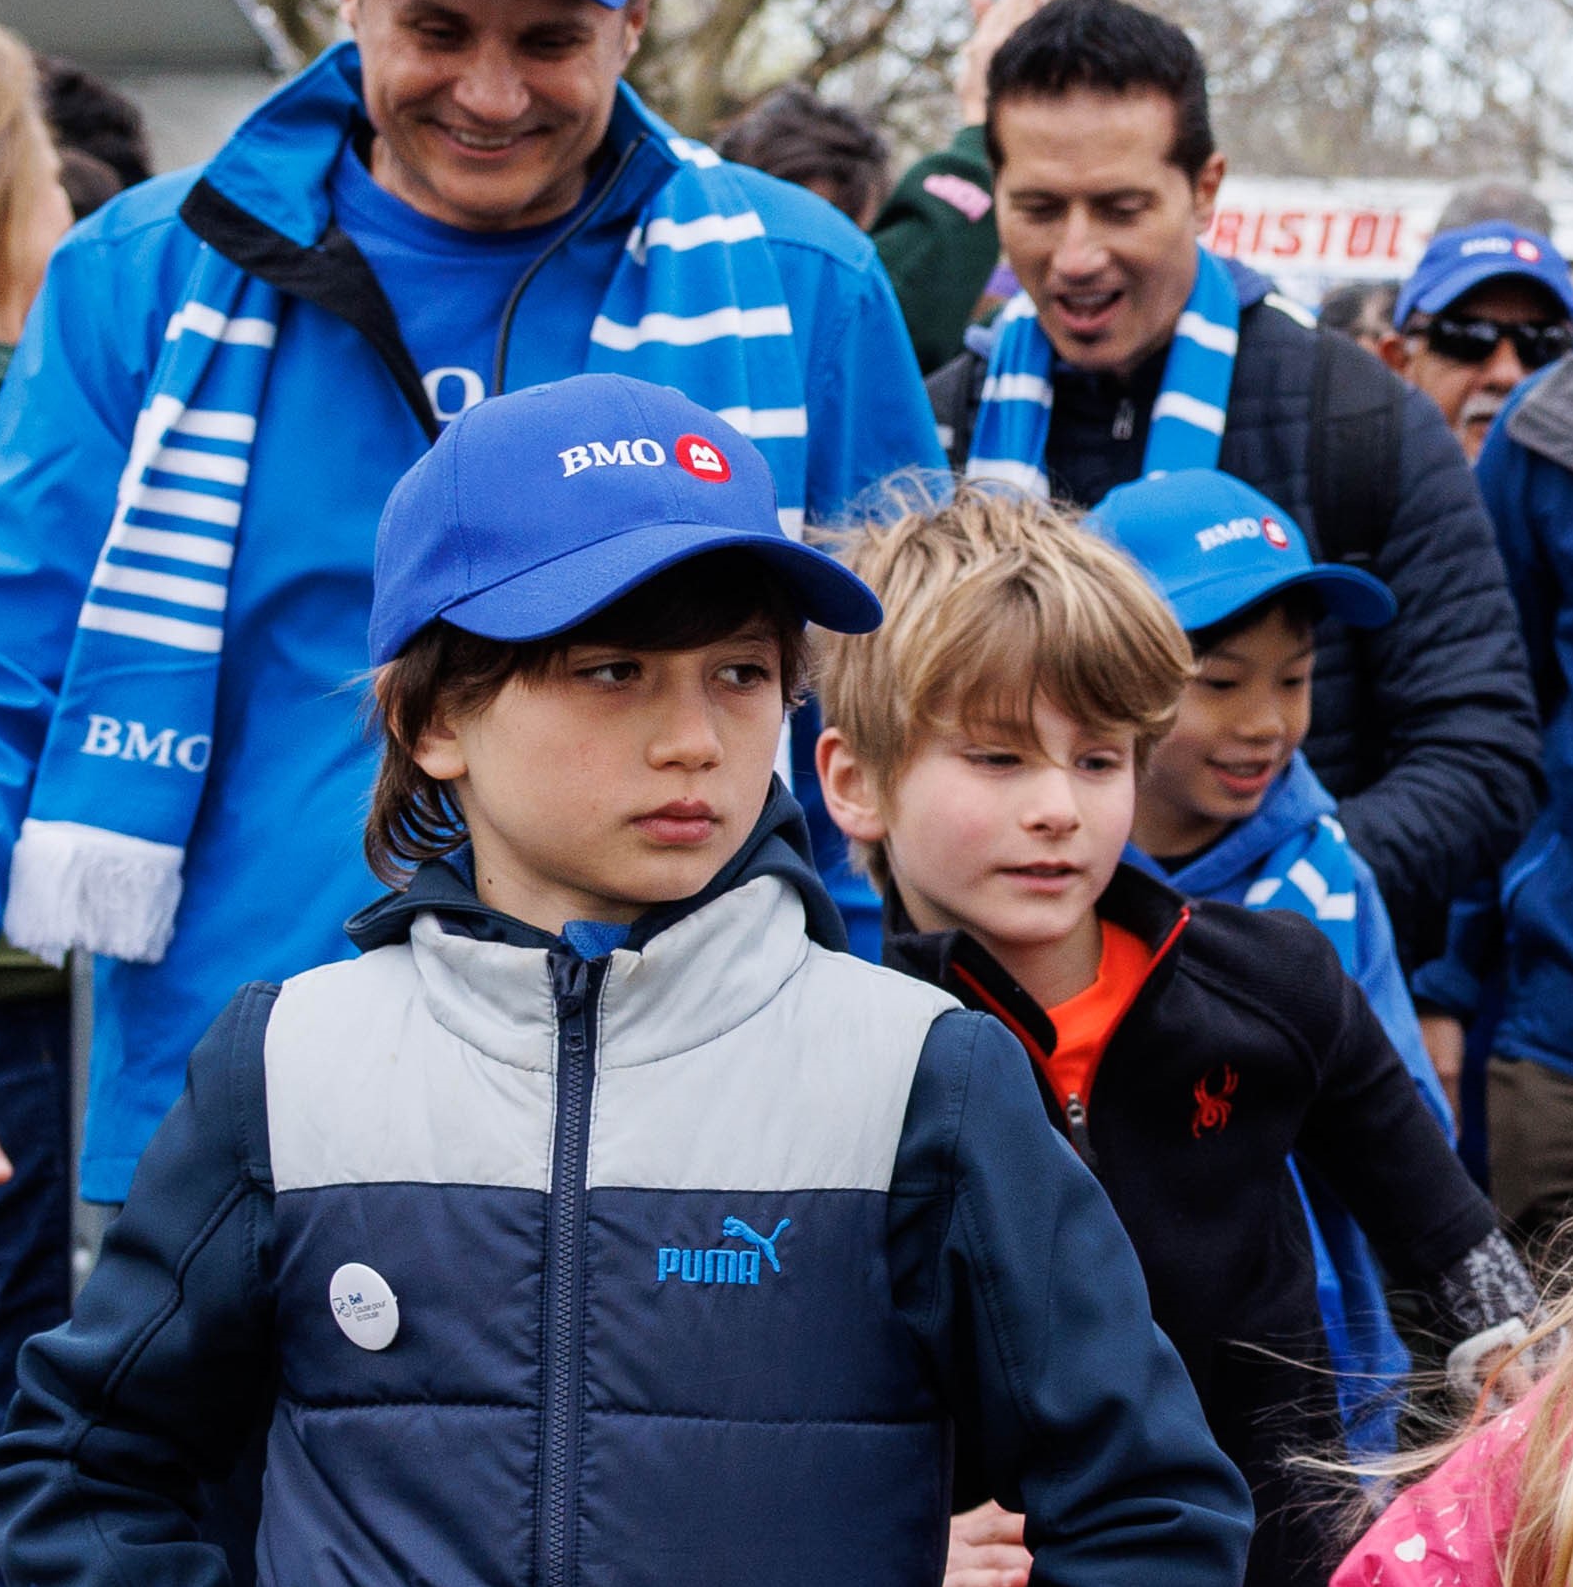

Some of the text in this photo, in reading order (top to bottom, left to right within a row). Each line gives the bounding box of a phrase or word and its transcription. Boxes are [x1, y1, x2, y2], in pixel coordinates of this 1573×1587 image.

[1210, 209, 1405, 261] RISTOL
[557, 437, 667, 479] BMO
[79, 713, 213, 774] BMO
[656, 1247, 761, 1285] PUMA
